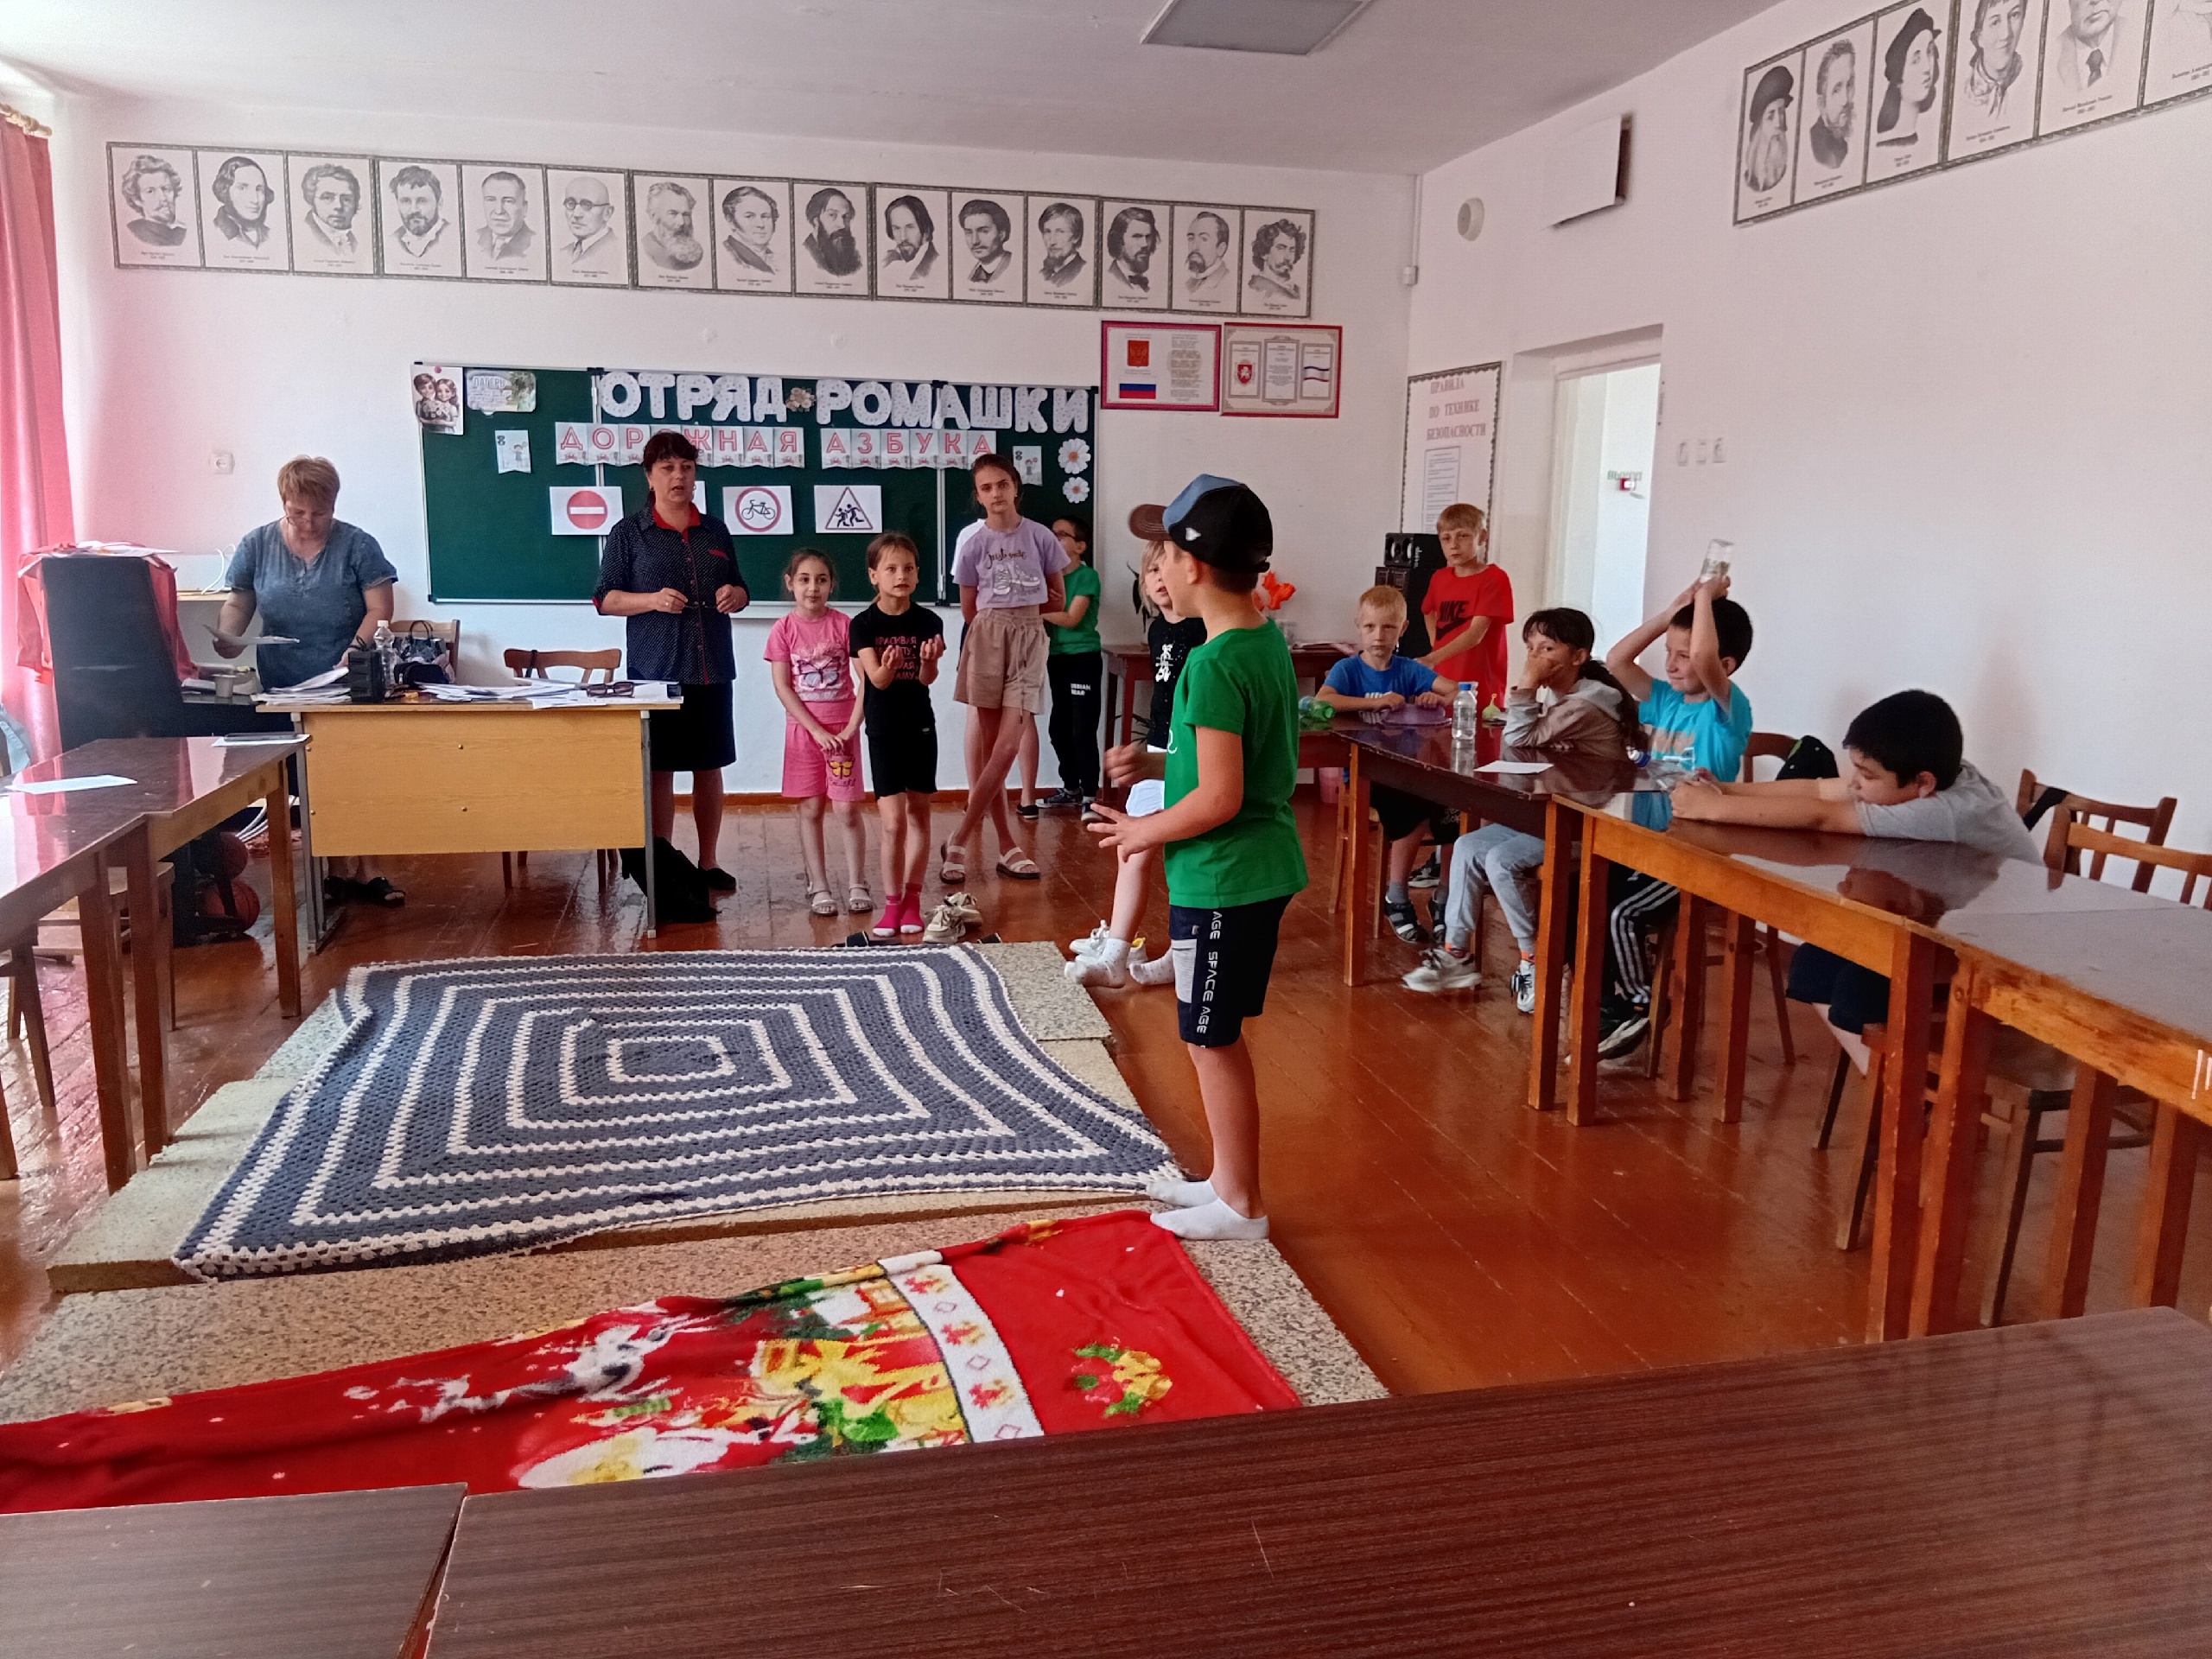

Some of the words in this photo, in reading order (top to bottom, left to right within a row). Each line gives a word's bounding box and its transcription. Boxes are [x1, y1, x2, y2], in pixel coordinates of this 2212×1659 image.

[1430, 378, 1465, 394] ПРАВИЛА
[599, 371, 787, 423] ОТРЯД
[816, 378, 1089, 434] РОМАШКИ
[1428, 406, 1440, 419] ПО
[1445, 399, 1480, 416] ТЕХНИКЕ
[560, 426, 798, 453] ДОРЖНАЯ
[825, 432, 992, 455] АЗБУКА
[1426, 423, 1486, 441] БЕЗОПАСНОСТИ
[1440, 601, 1470, 621] NIKE
[1210, 911, 1223, 940] AGE
[1202, 951, 1218, 1002] SPACE
[1196, 1006, 1211, 1034] AGE
